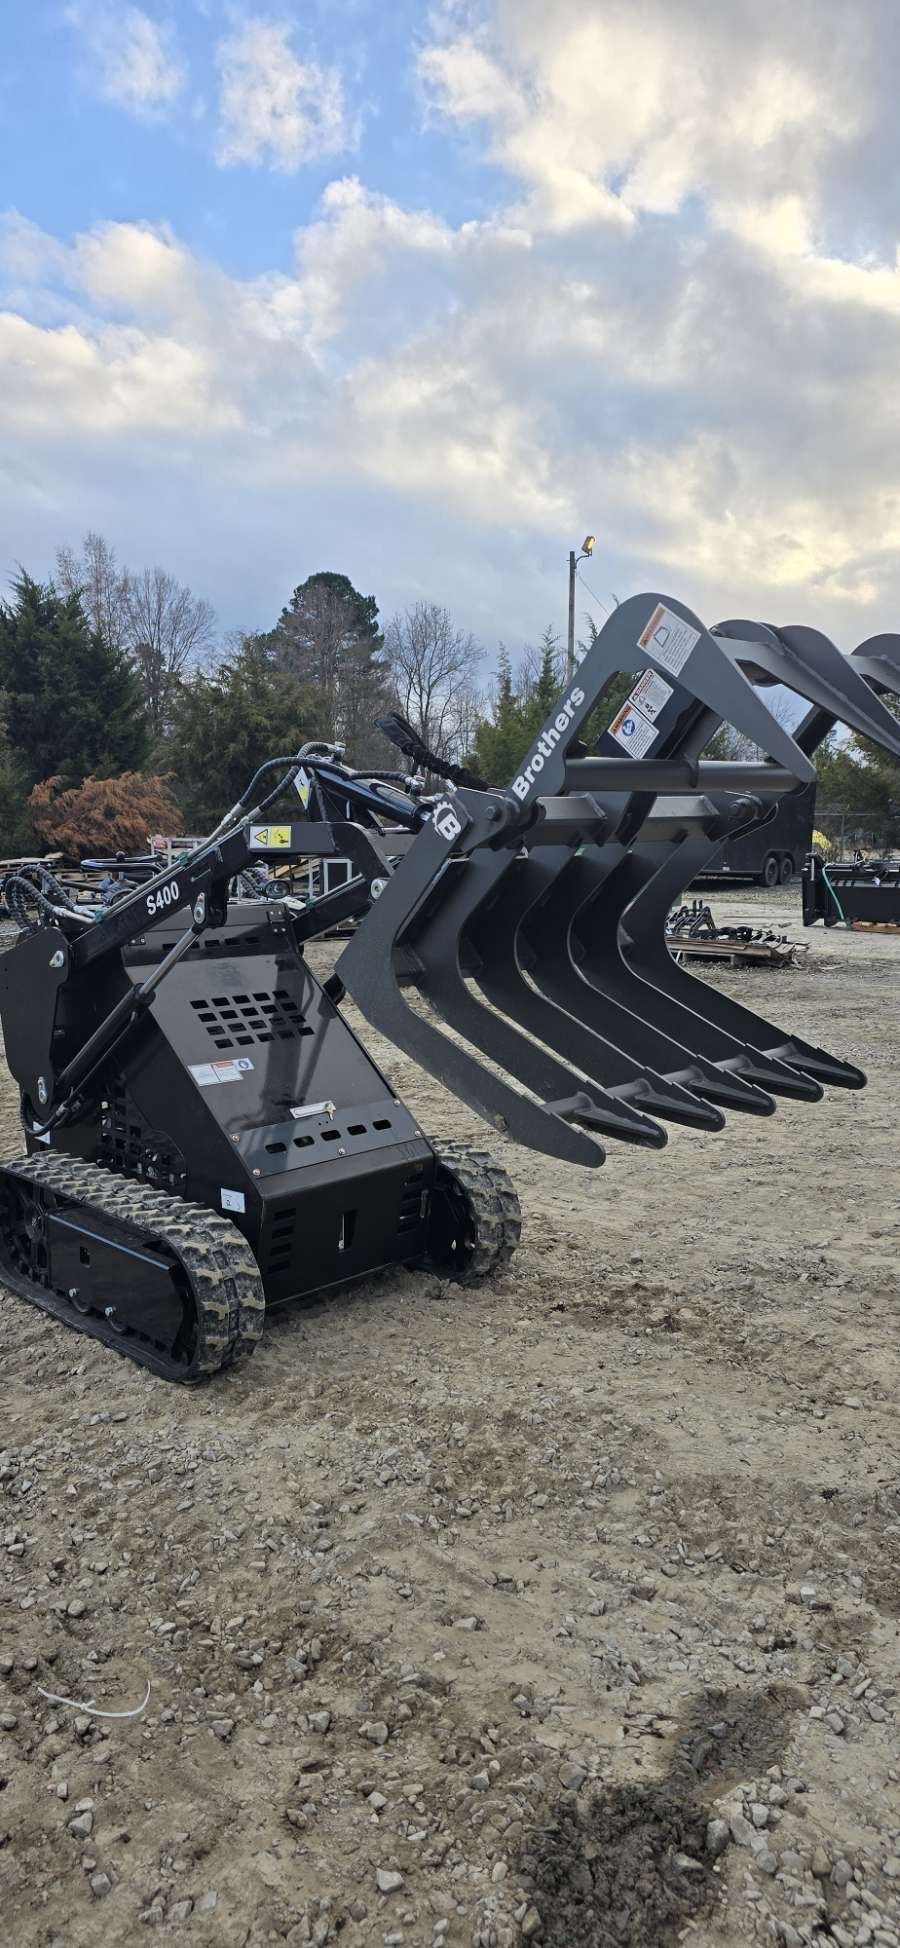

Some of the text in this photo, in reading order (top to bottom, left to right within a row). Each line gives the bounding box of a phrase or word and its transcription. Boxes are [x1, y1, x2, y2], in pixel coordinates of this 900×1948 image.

[511, 687, 585, 800] Brothers
[437, 813, 461, 841] B
[146, 881, 179, 915] S400
